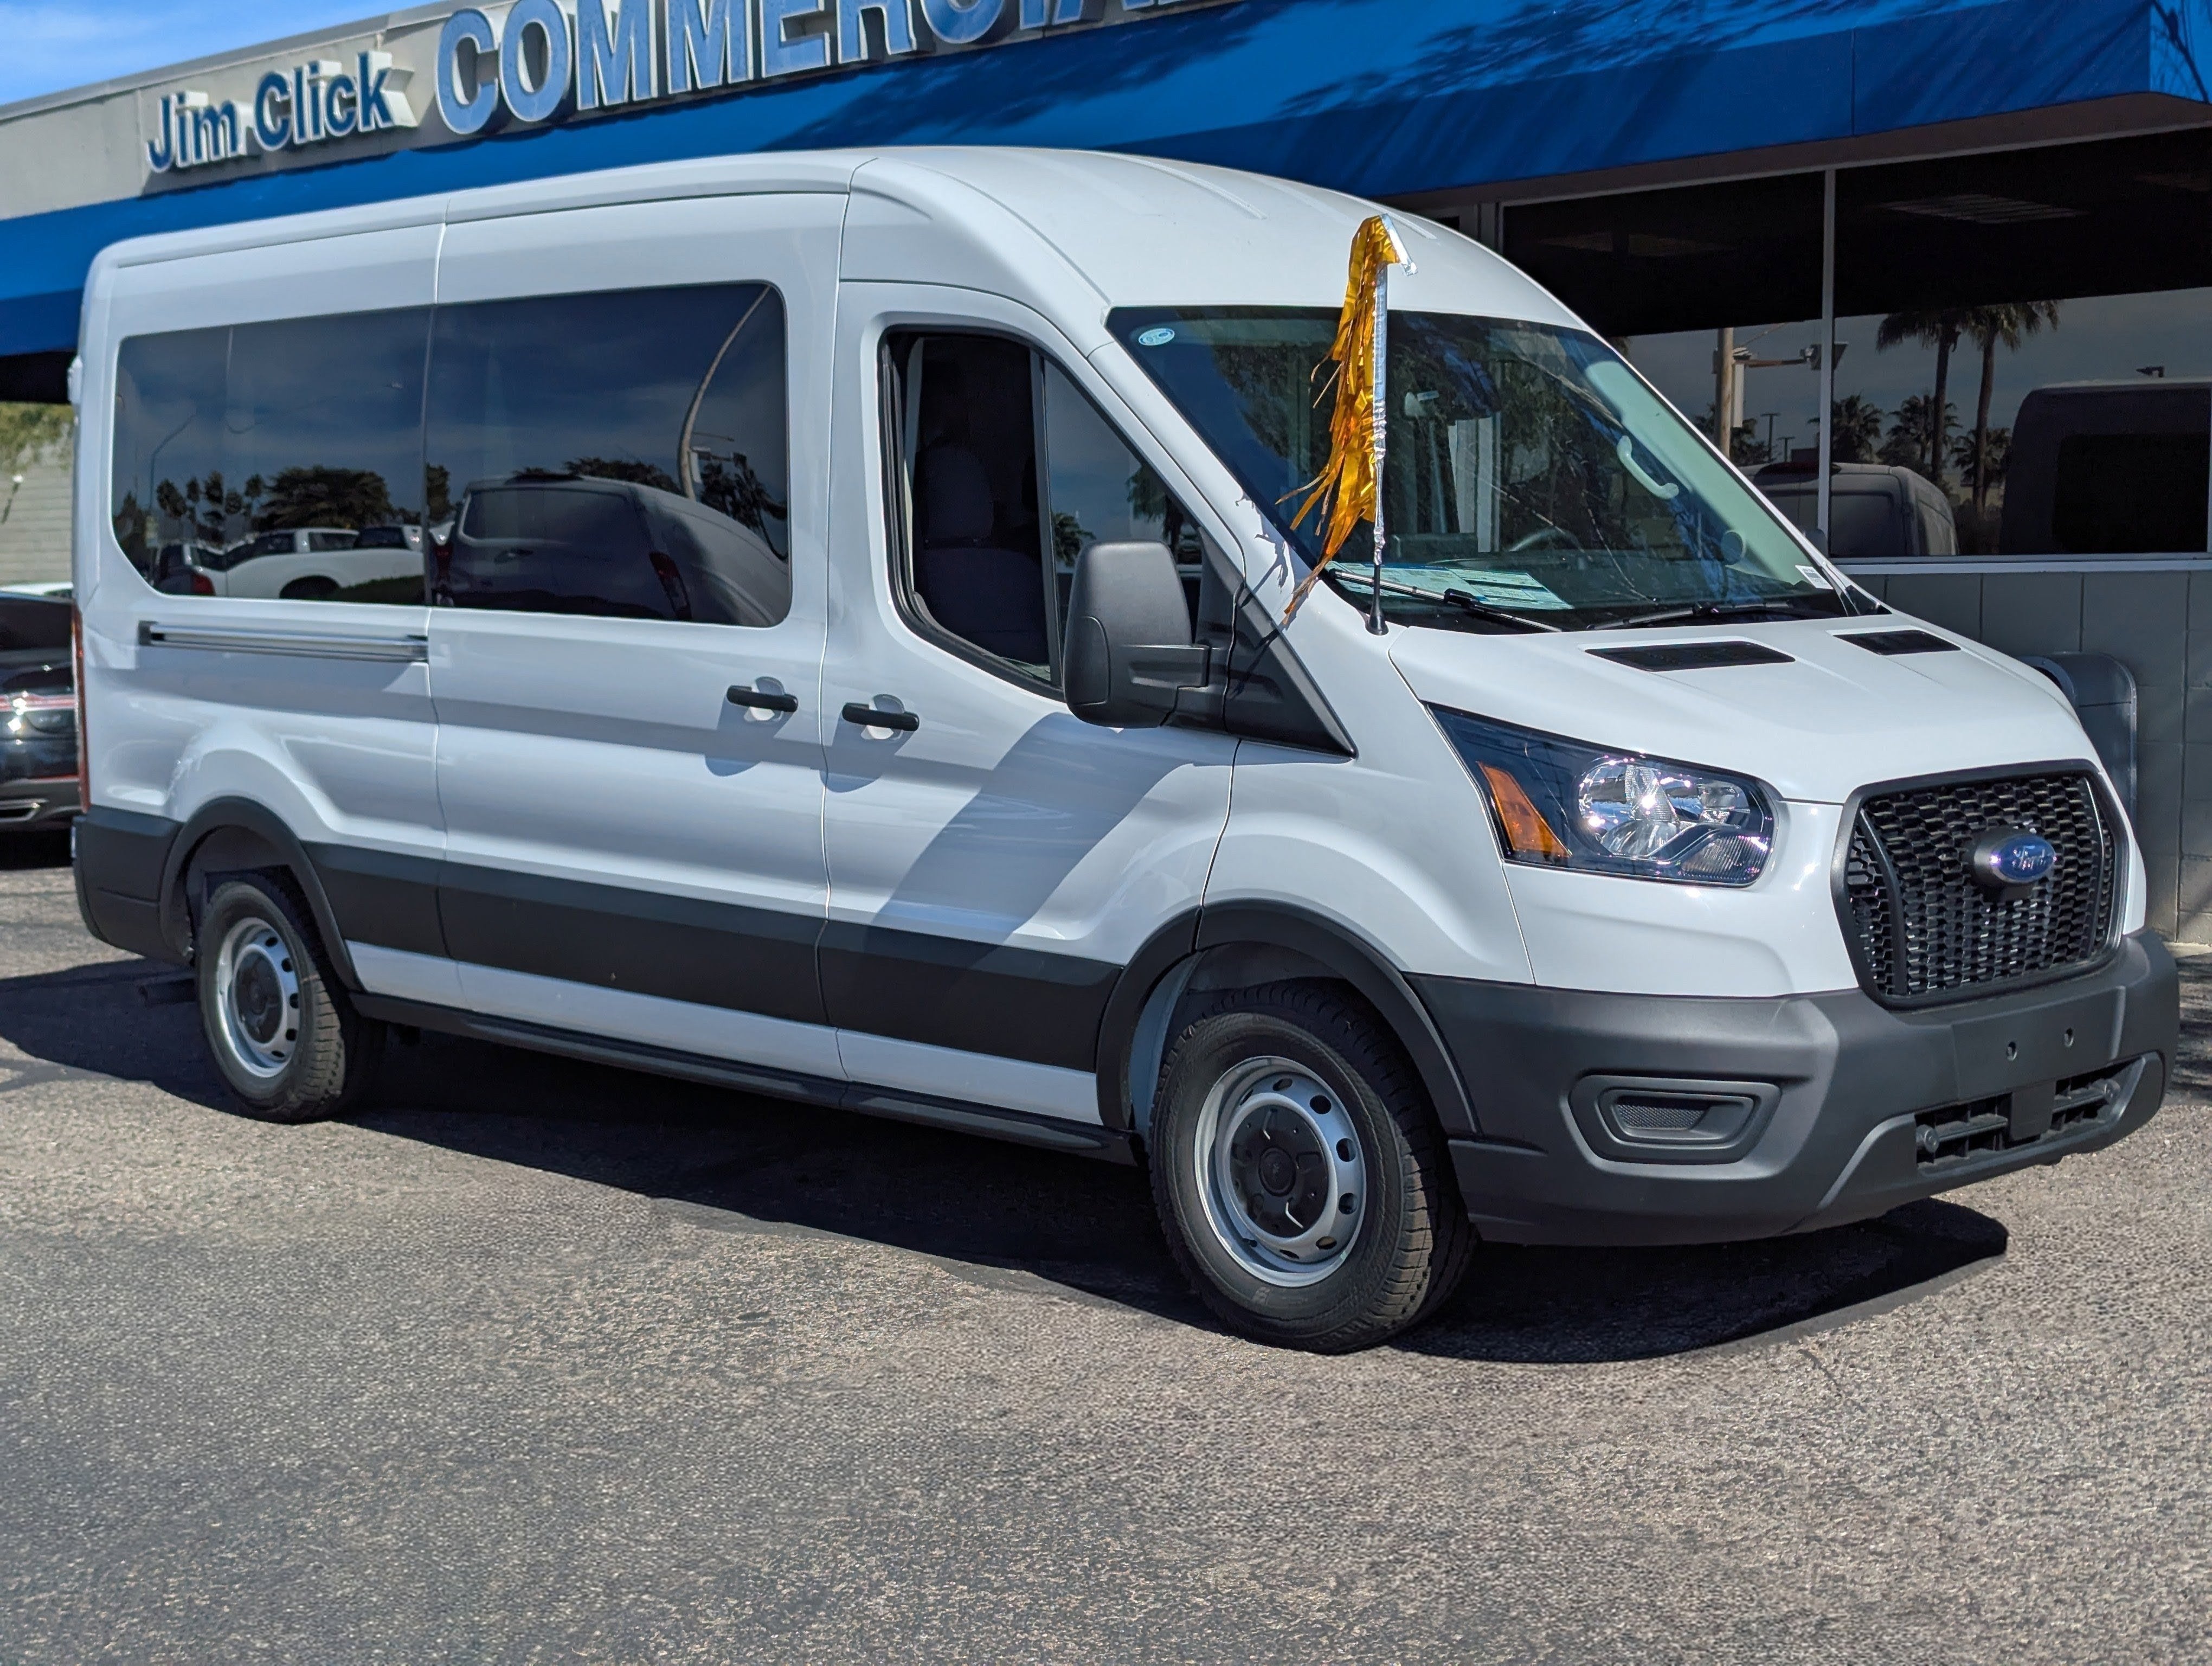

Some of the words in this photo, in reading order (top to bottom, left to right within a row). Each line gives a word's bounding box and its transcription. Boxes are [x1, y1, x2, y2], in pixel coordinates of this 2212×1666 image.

[146, 91, 242, 172] Jim
[254, 52, 395, 151] Click
[435, 0, 1178, 134] COMME
